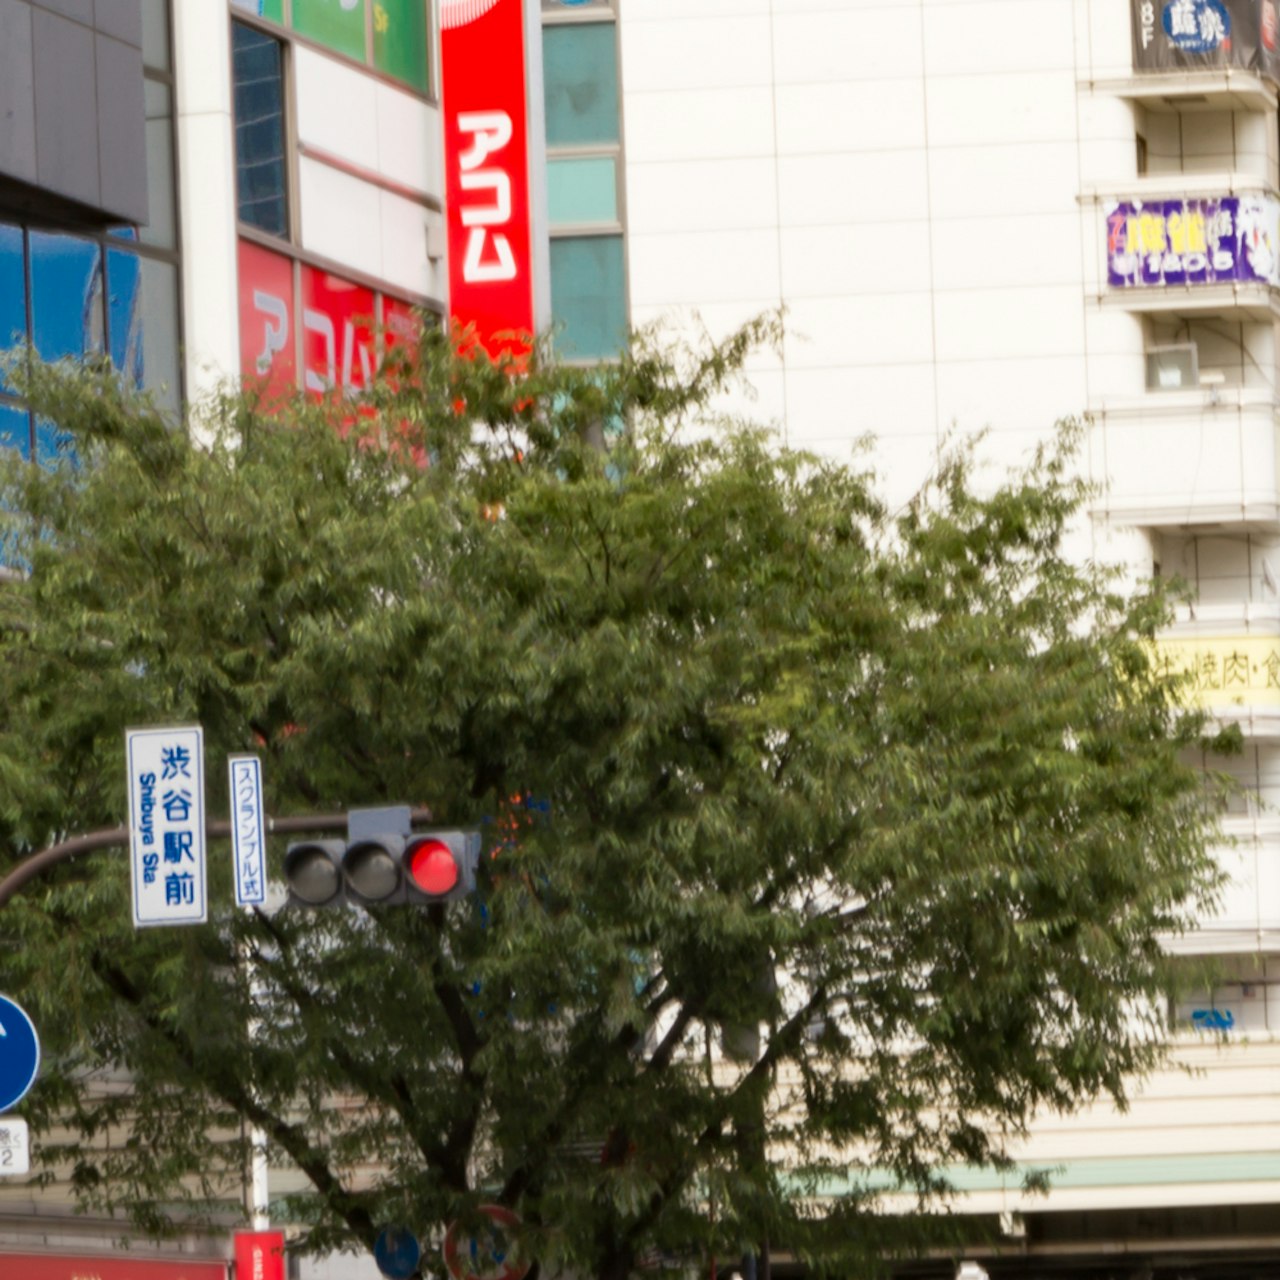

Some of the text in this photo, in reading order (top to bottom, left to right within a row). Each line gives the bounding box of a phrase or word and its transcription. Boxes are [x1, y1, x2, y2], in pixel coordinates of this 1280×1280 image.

[457, 111, 517, 282] アコム
[140, 772, 157, 845] Shibuya
[160, 745, 195, 906] 渋谷駅前
